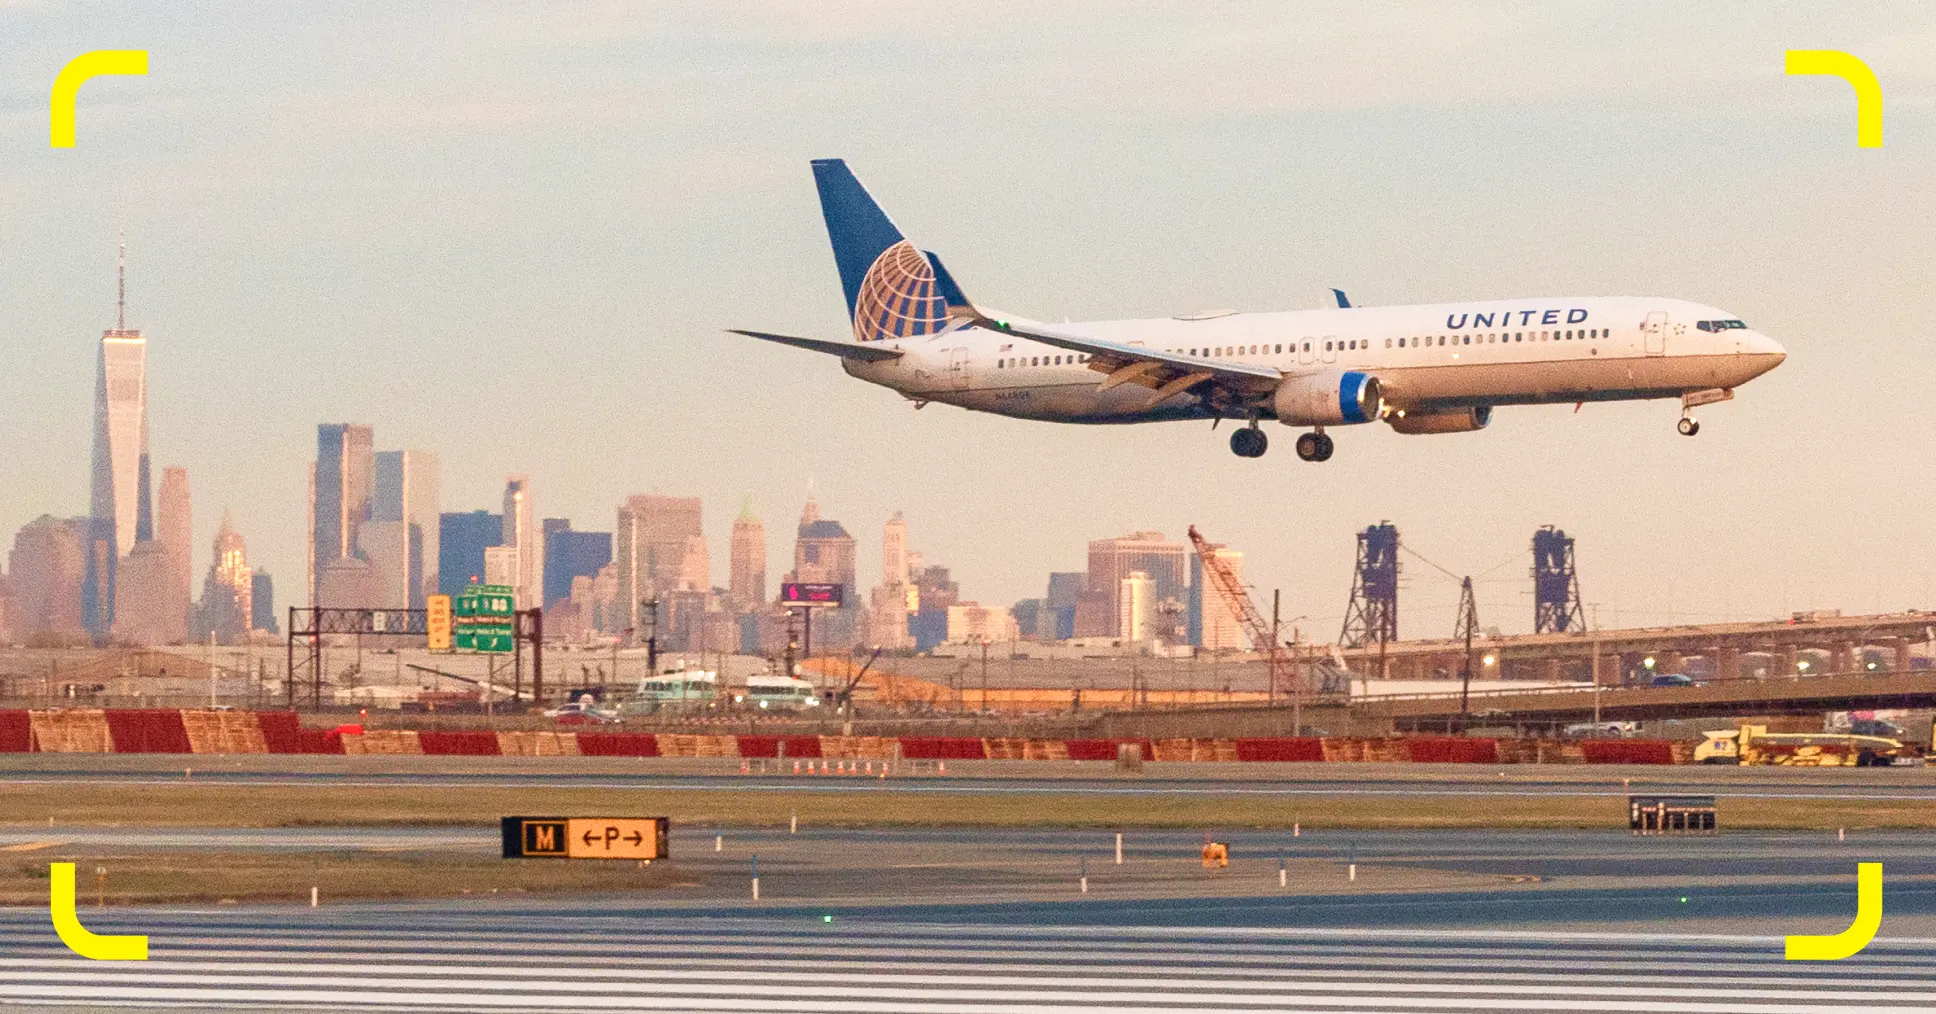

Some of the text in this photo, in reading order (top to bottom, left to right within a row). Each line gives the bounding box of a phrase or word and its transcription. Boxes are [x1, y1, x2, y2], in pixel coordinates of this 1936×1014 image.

[1446, 308, 1588, 330] UNITED
[535, 825, 620, 850] M P
